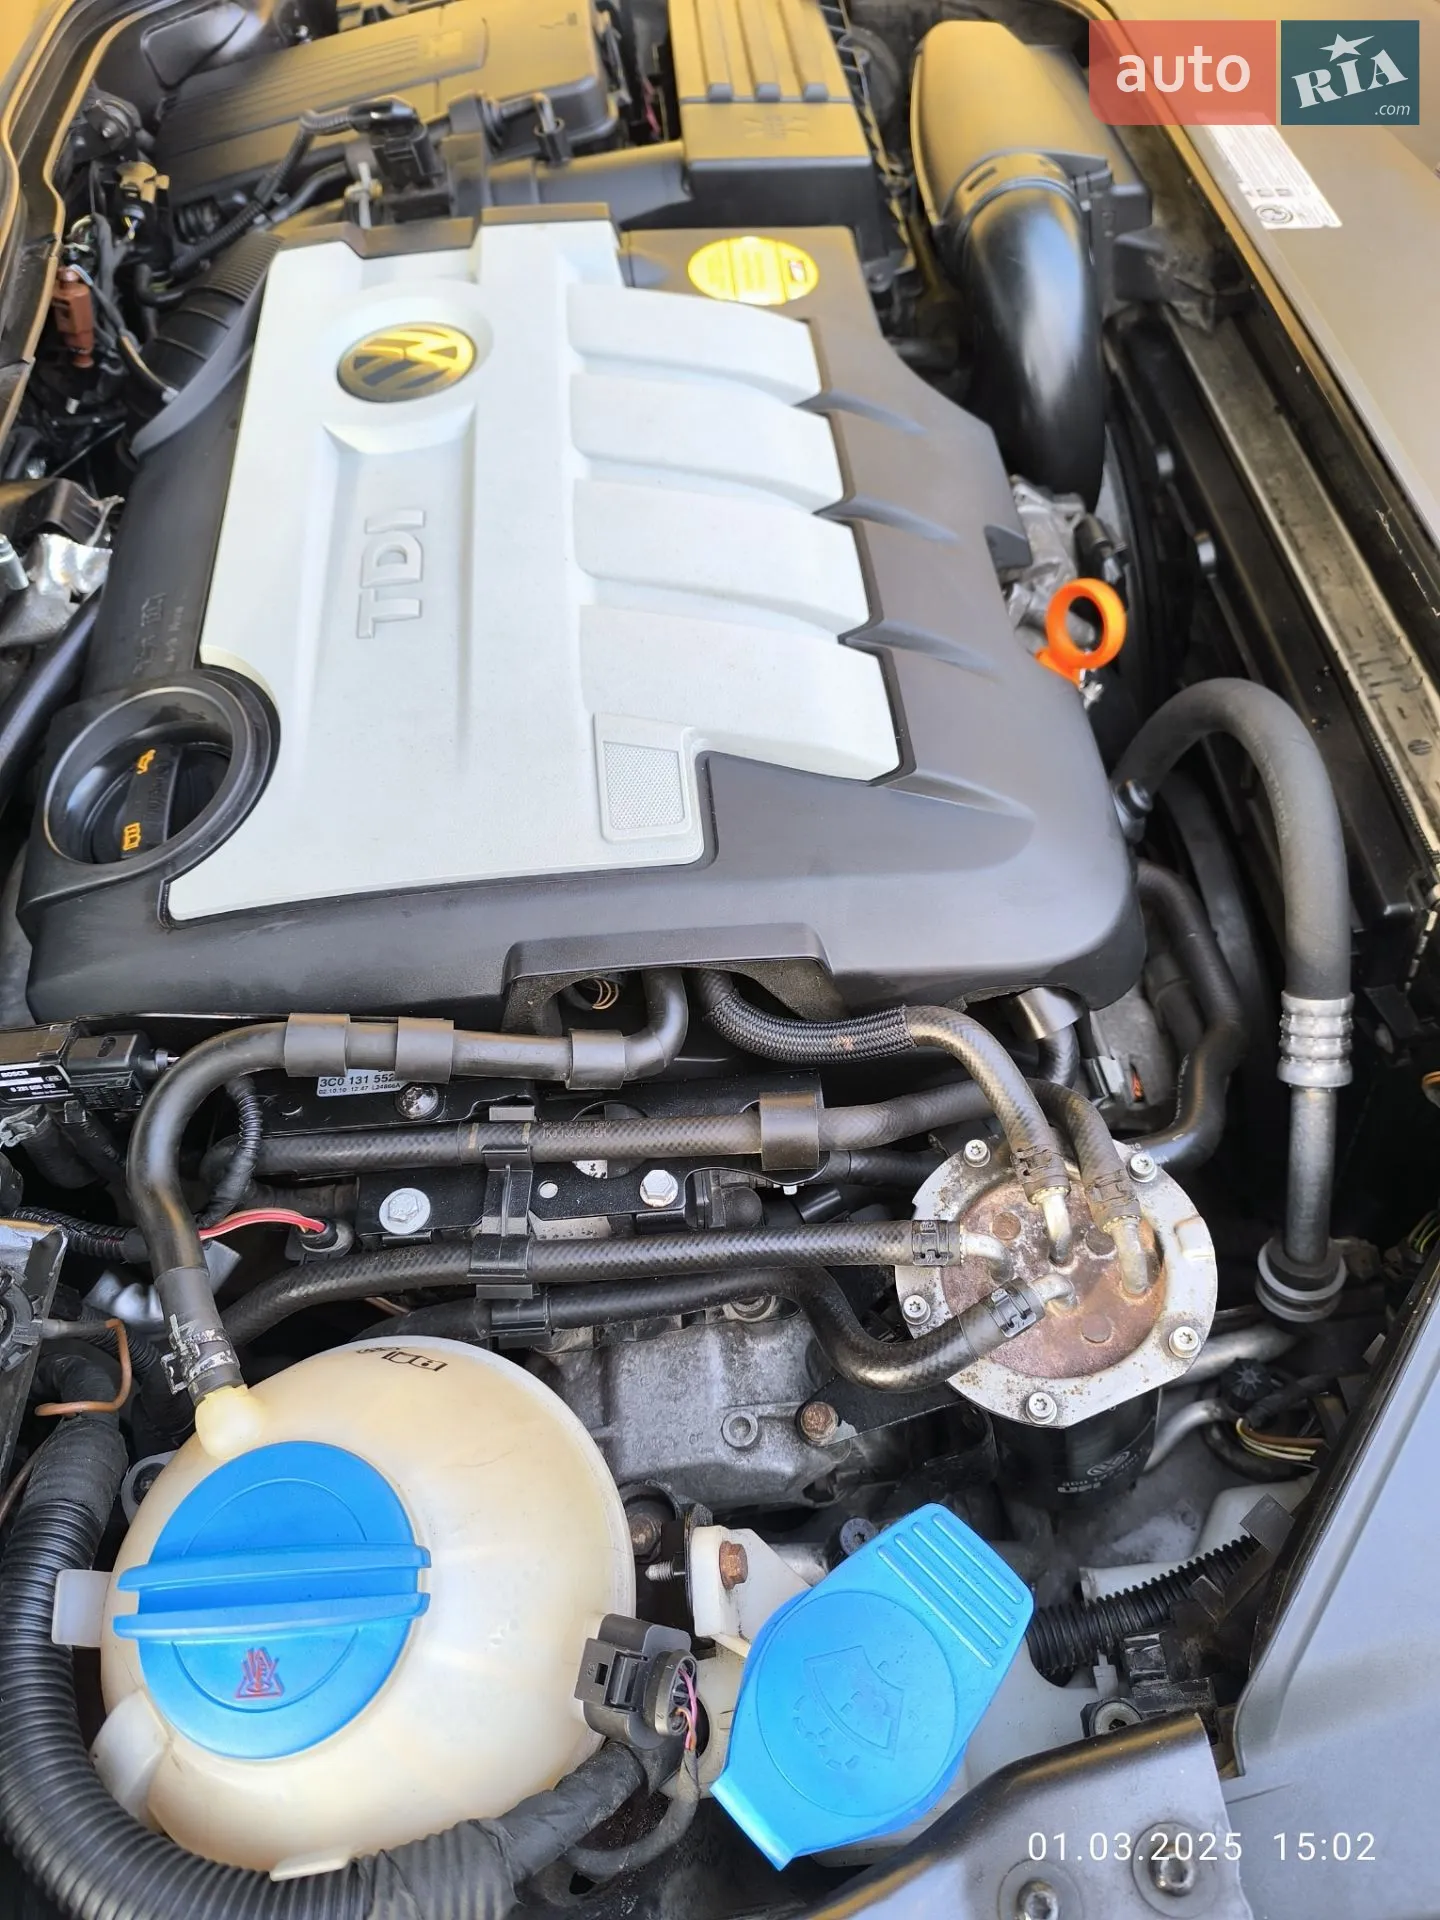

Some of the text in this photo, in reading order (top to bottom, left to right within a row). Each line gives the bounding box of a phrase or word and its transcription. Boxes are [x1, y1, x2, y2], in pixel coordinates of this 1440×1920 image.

[356, 508, 426, 639] TDI
[319, 1077, 345, 1087] 3C0
[349, 1075, 369, 1085] 131
